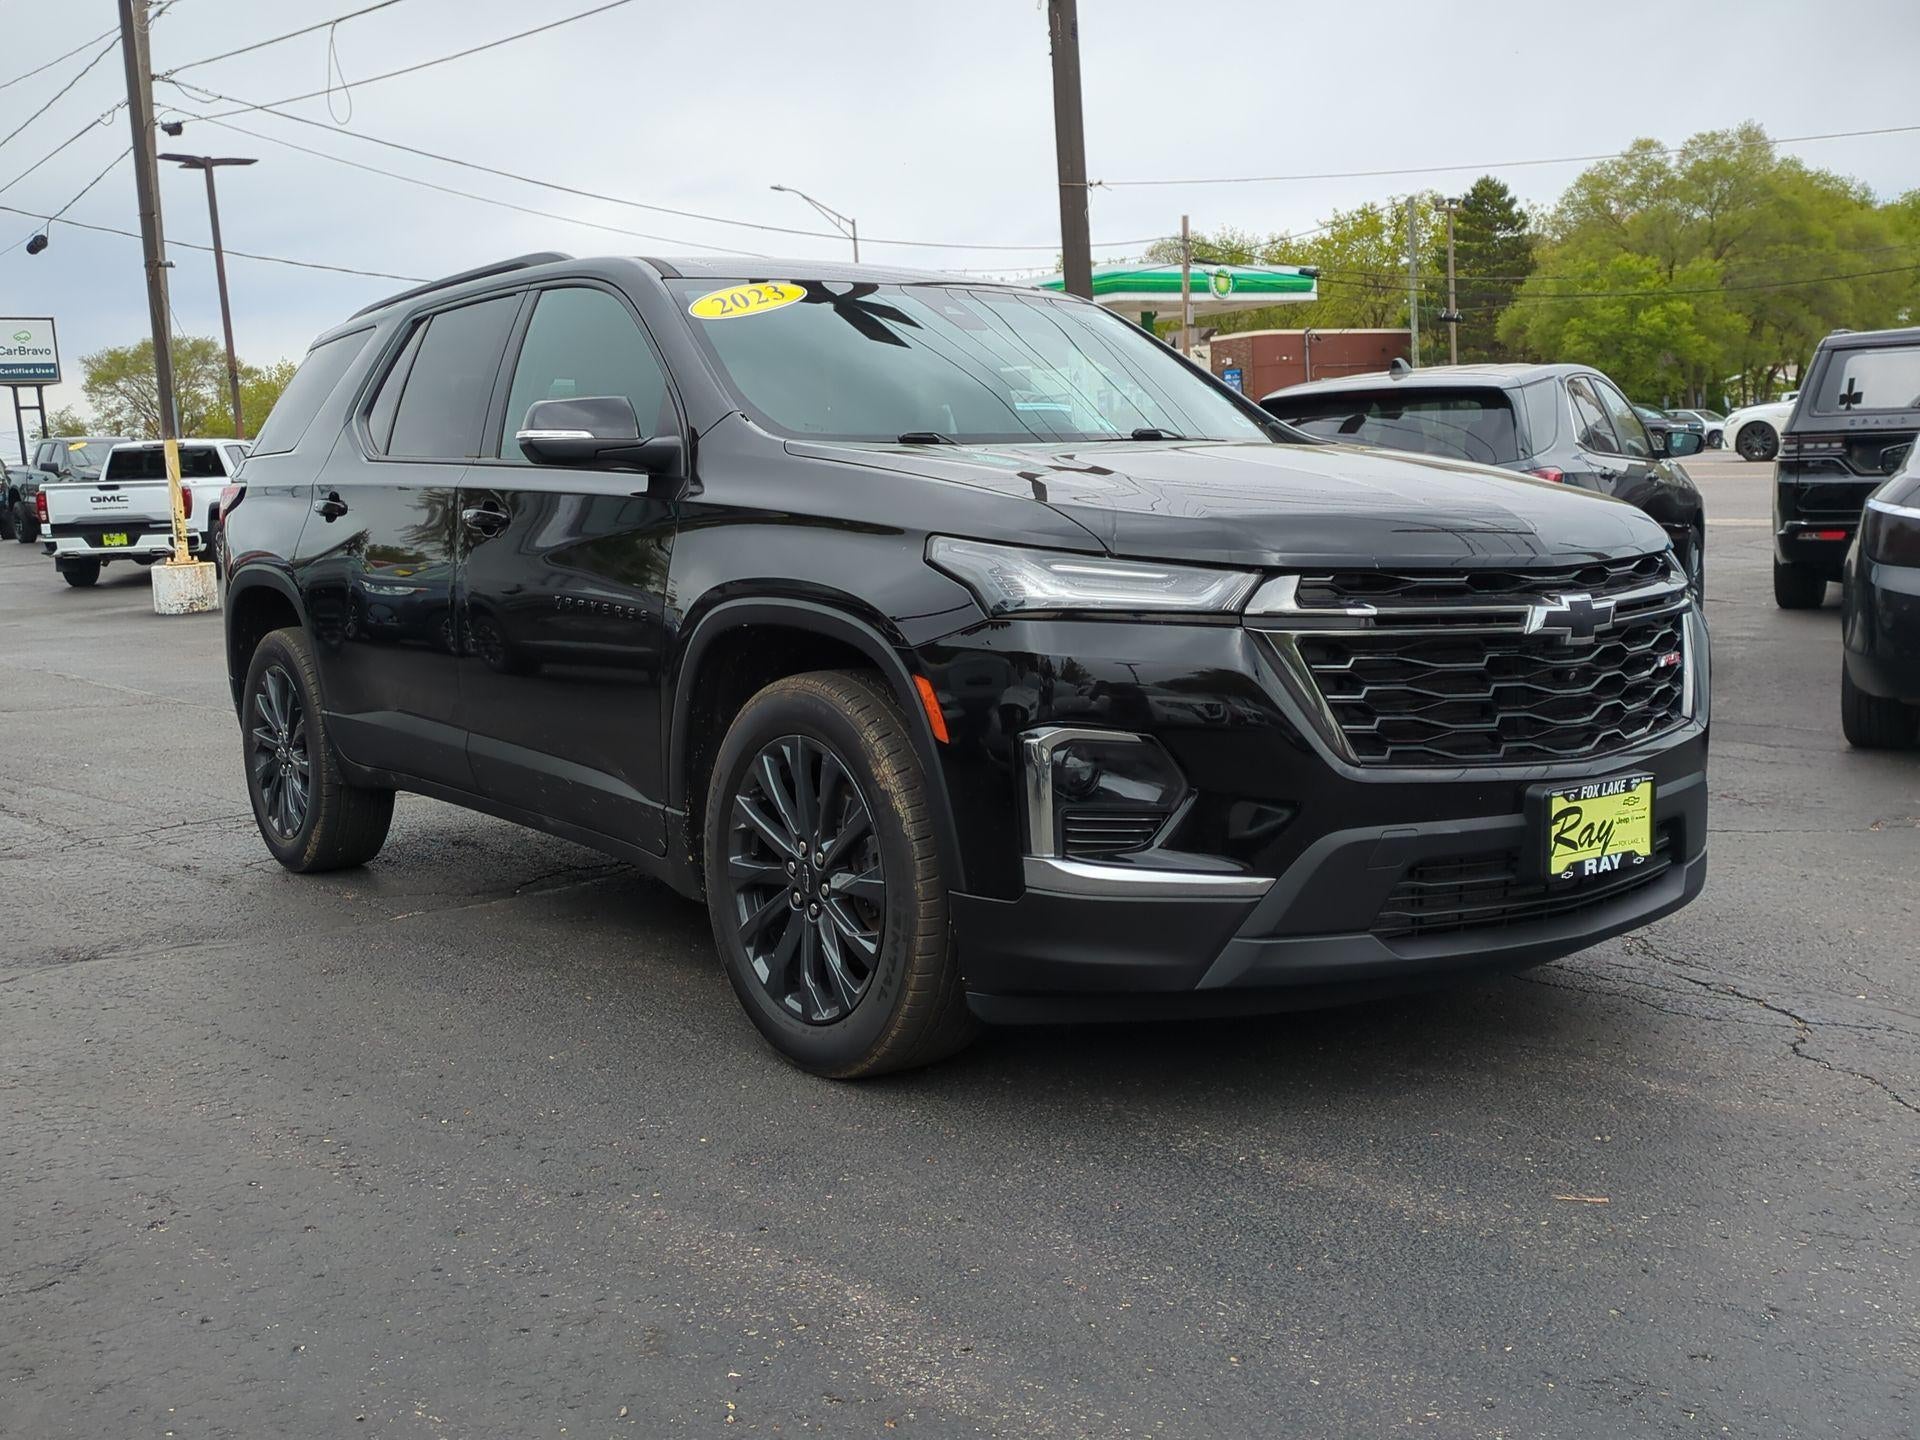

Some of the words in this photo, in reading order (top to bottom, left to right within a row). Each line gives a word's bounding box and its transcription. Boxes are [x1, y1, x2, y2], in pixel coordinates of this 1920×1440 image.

[711, 285, 785, 315] 2023
[0, 346, 51, 355] CarBravo
[1581, 785, 1599, 799] FOX
[1602, 780, 1626, 796] LAKE
[1552, 806, 1615, 856] Ray
[1585, 854, 1623, 876] RAY
